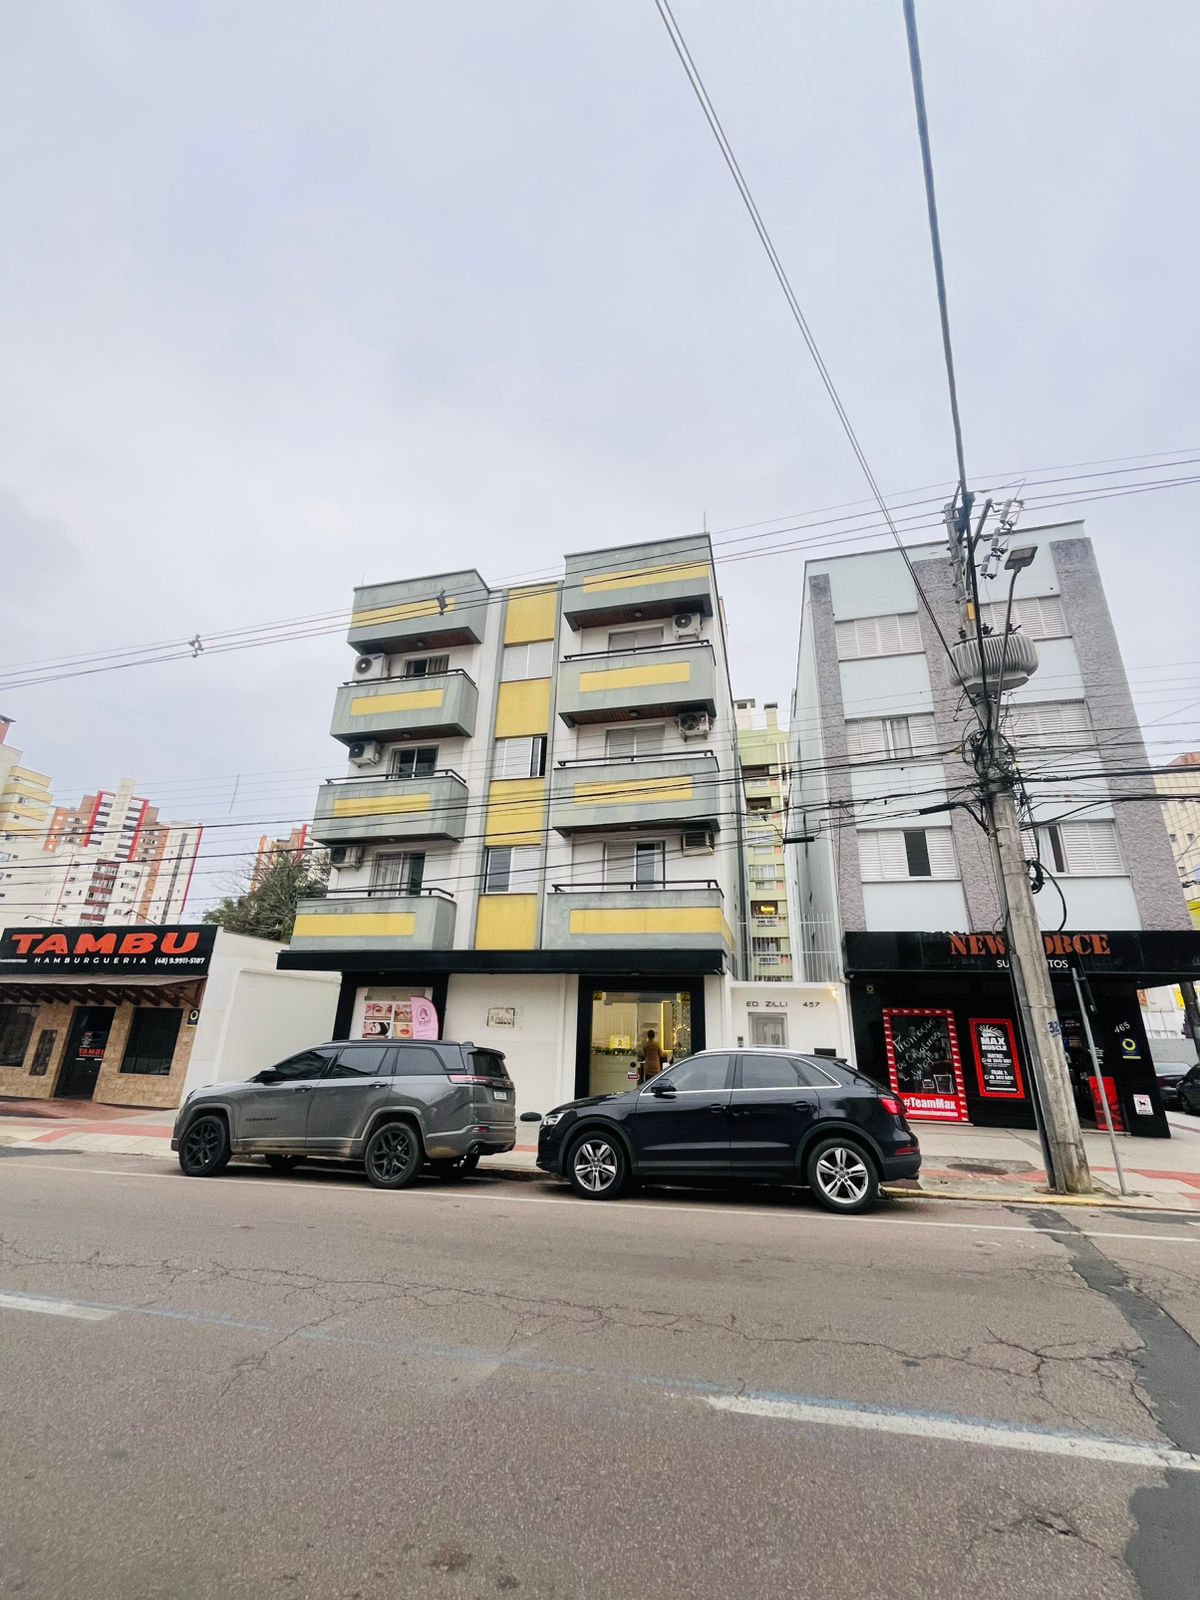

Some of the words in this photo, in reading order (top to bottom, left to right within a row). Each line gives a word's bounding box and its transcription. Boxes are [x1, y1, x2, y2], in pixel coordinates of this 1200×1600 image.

[11, 932, 200, 954] TAMBU
[949, 934, 1006, 955] NEW
[745, 1000, 759, 1008] ED
[765, 1000, 788, 1008] ZILLI
[1114, 1021, 1131, 1033] 465
[980, 1037, 1006, 1045] MAX
[903, 1096, 957, 1109] #TeamMax
